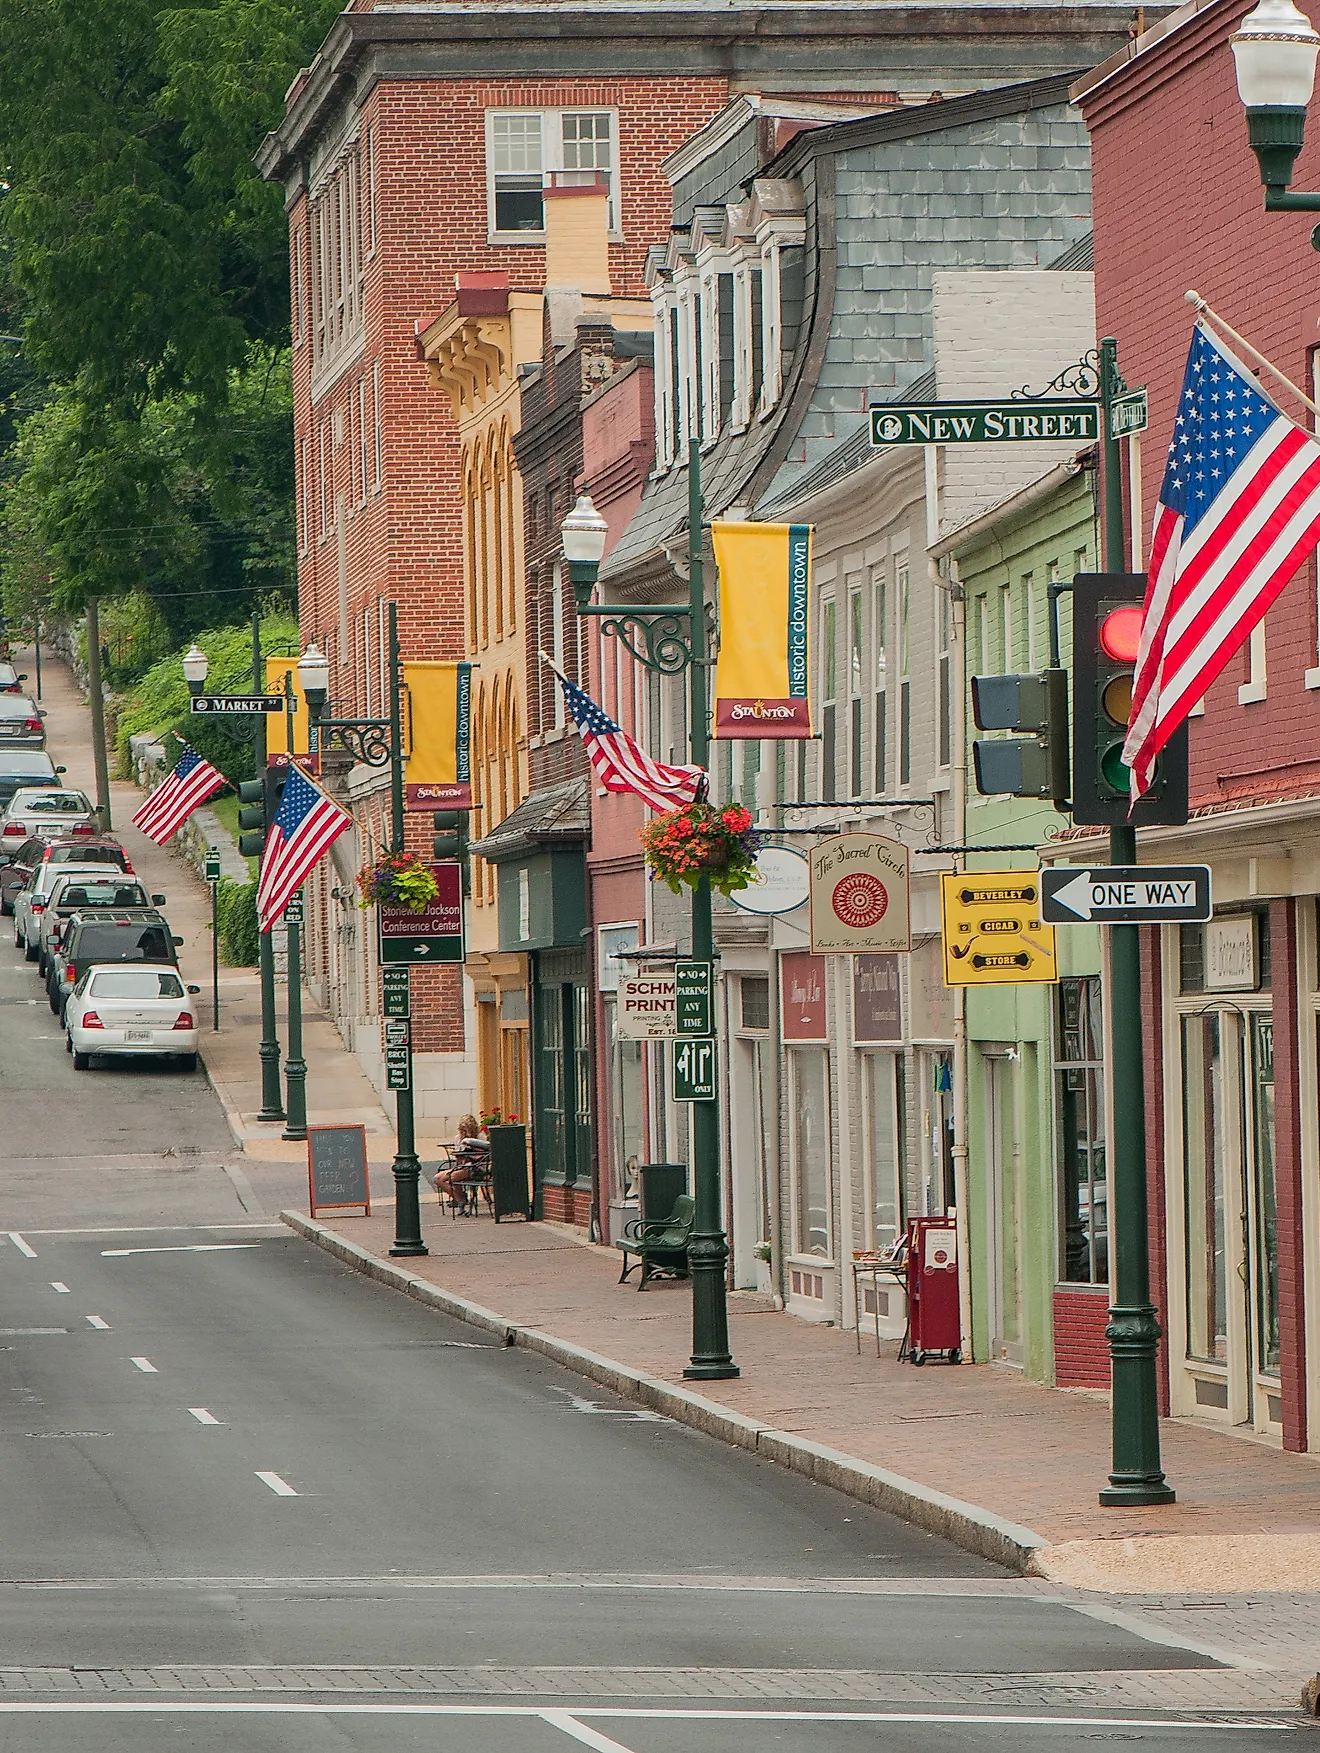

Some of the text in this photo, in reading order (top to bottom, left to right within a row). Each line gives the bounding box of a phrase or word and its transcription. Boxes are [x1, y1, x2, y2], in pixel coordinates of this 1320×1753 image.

[906, 413, 977, 440] NEW
[984, 411, 1093, 439] STREET
[789, 541, 807, 696] historic downtown
[212, 699, 264, 711] MARKET
[731, 704, 797, 720] STAUNTON
[458, 674, 470, 782] historic downtown
[416, 787, 462, 799] STAUNTON
[814, 843, 905, 880] The Sacred Circle
[973, 890, 1024, 900] BEVERLEY
[1092, 882, 1193, 906] ONE WAY
[425, 903, 460, 915] Jackson
[382, 919, 460, 932] Conference Center
[984, 921, 1015, 931] CIGAR
[985, 956, 1017, 965] STORE
[686, 970, 698, 979] NO
[676, 986, 708, 996] PARKING
[684, 1002, 701, 1012] ANY
[682, 1018, 703, 1028] TIME
[694, 1085, 712, 1093] ONLY
